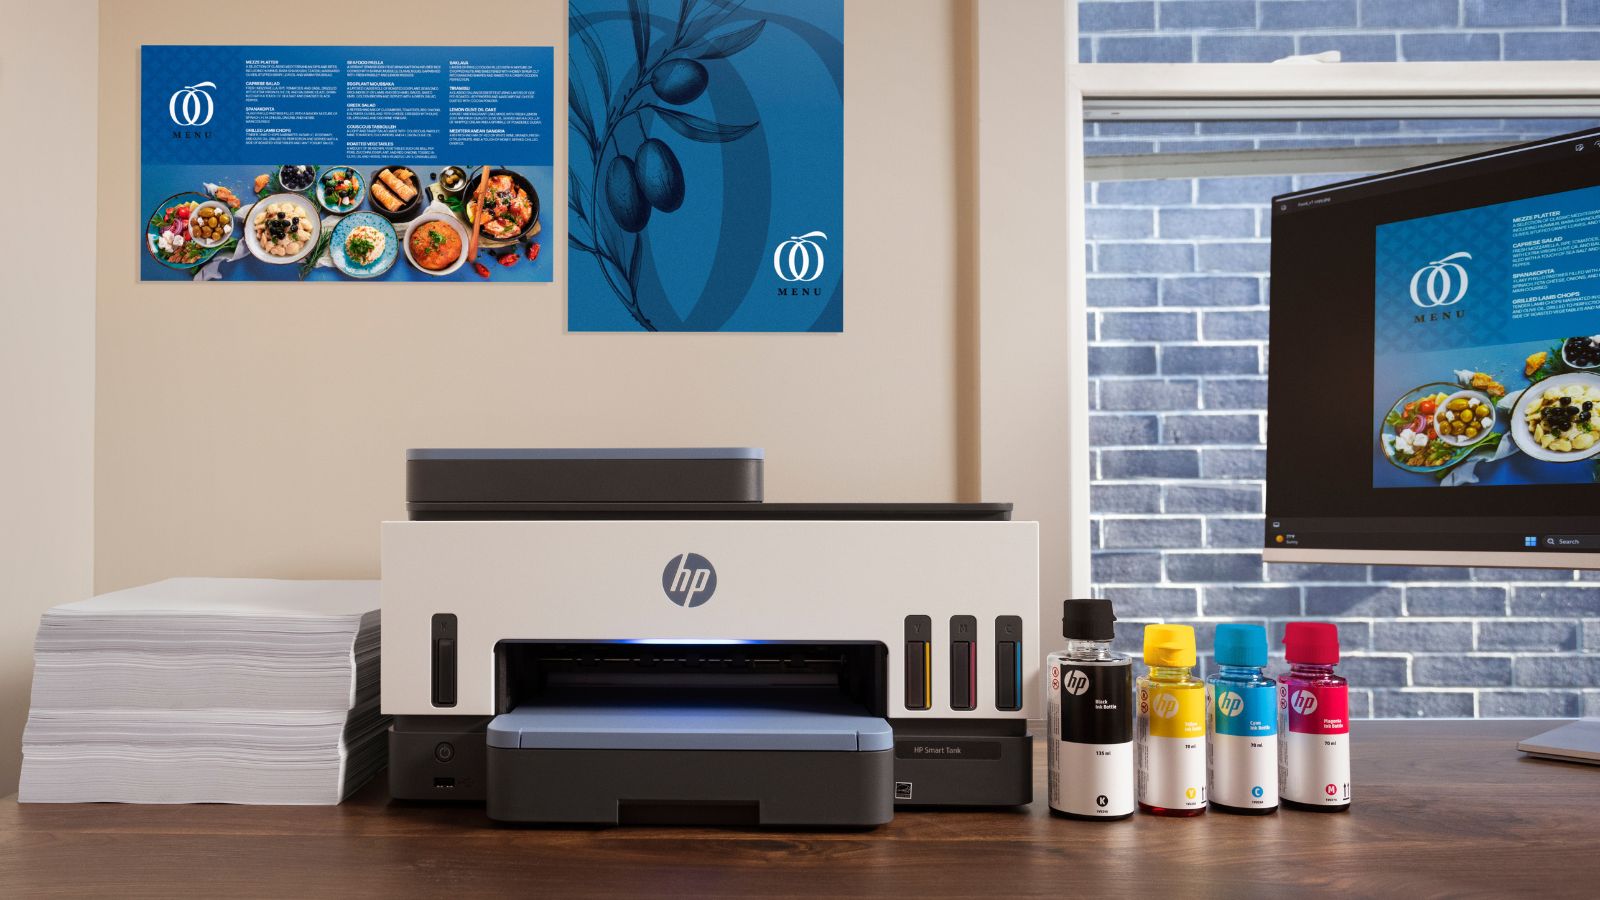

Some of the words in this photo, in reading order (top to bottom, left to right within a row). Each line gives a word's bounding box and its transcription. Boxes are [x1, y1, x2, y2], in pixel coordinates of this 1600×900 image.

[1534, 211, 1560, 220] PLATTER
[1513, 240, 1540, 248] CAPRESE
[1513, 269, 1554, 279] SPANAKOPITA
[777, 288, 822, 296] MENU
[1415, 310, 1464, 323] MENU
[667, 552, 713, 608] hp
[1066, 670, 1088, 696] hp
[1156, 693, 1177, 718] hp
[1220, 691, 1242, 716] hp
[1294, 690, 1316, 714] hp
